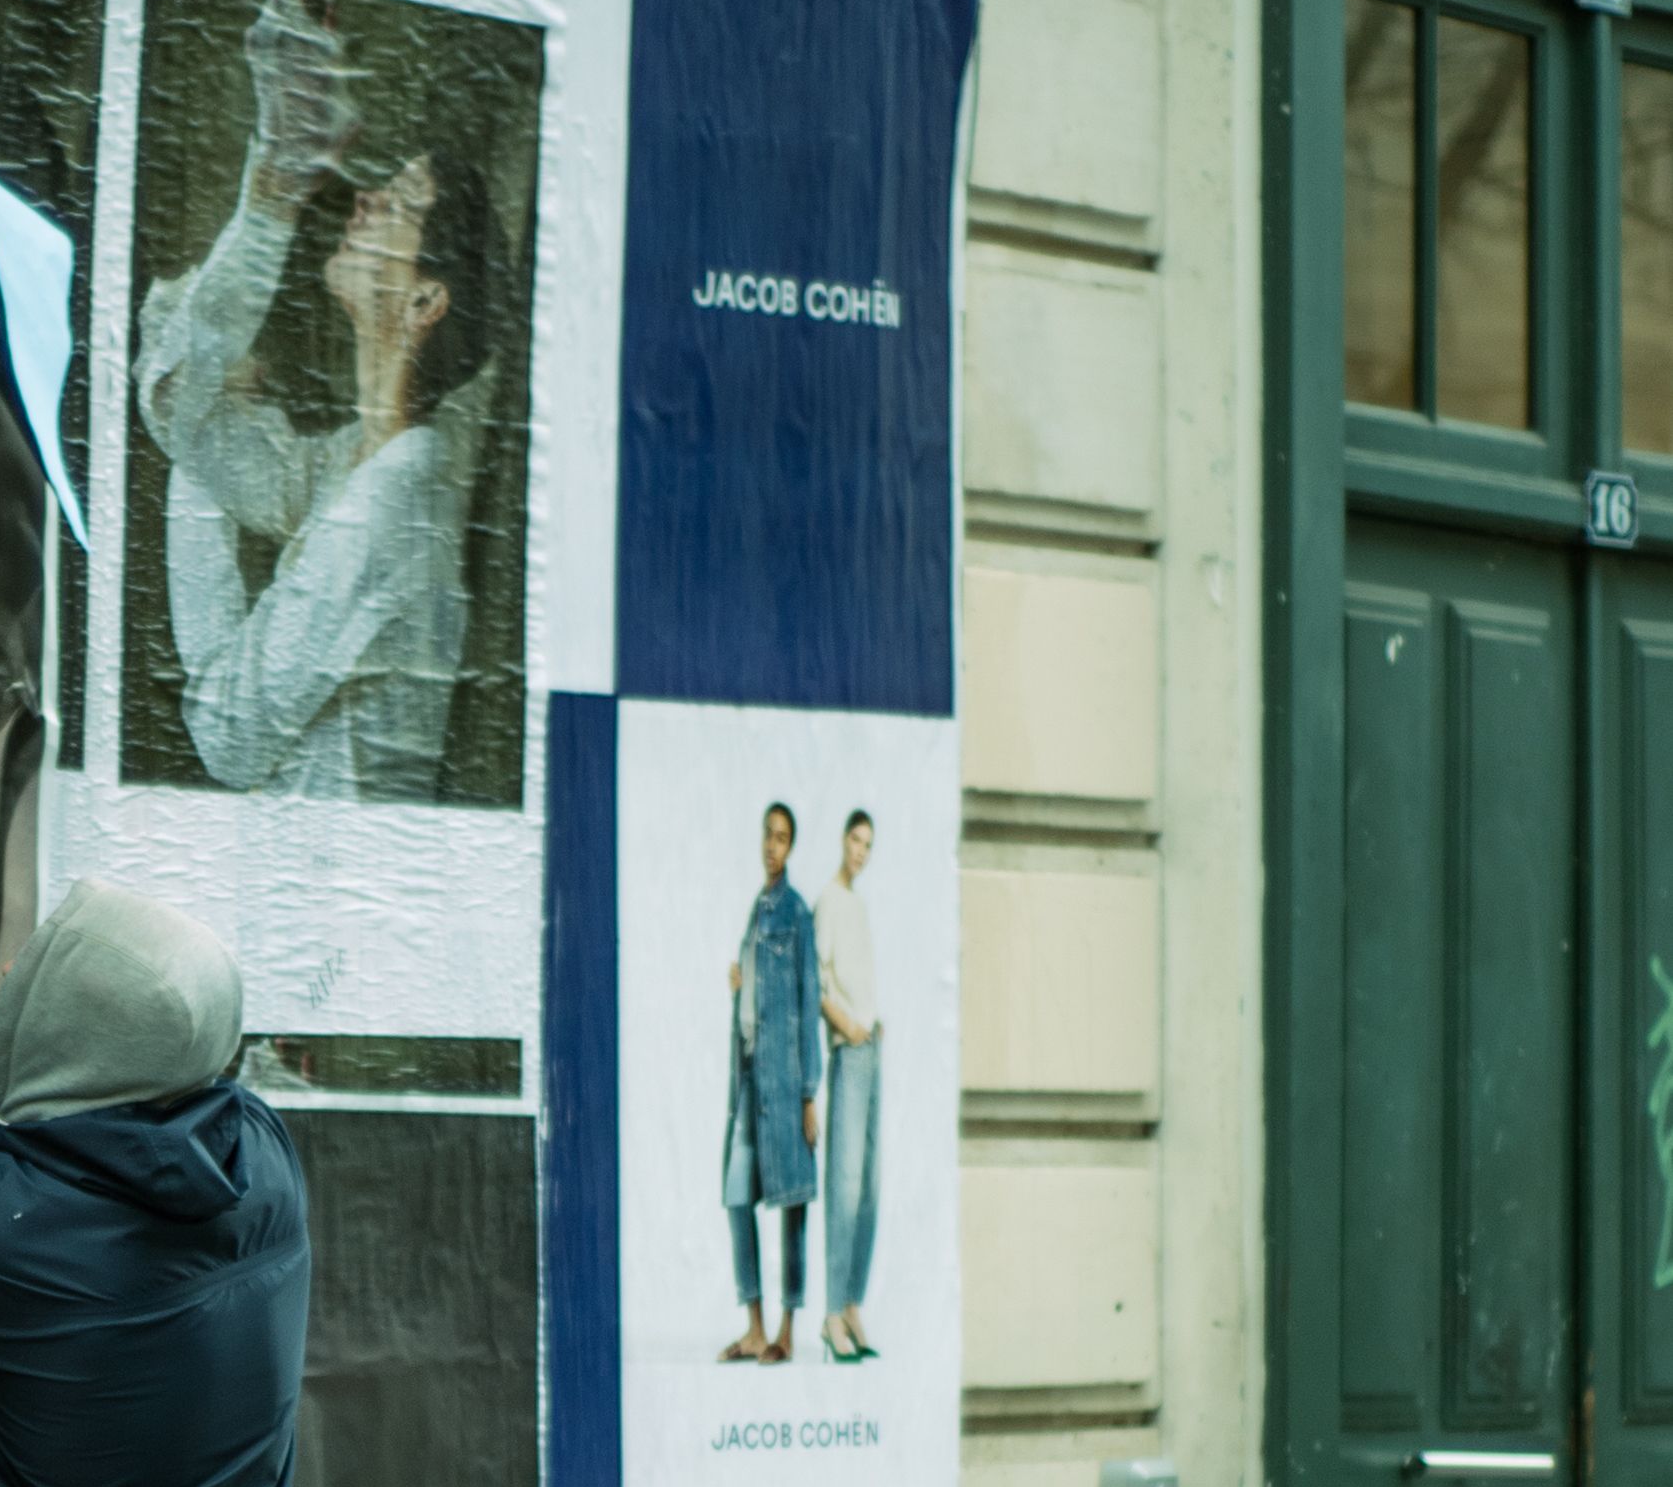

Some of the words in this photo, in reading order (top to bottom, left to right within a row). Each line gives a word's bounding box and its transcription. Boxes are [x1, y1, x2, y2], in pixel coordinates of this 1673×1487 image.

[692, 270, 798, 316] JACOB
[1595, 483, 1631, 536] 16
[711, 1423, 794, 1453] JACOB
[799, 1413, 880, 1449] COHËN
